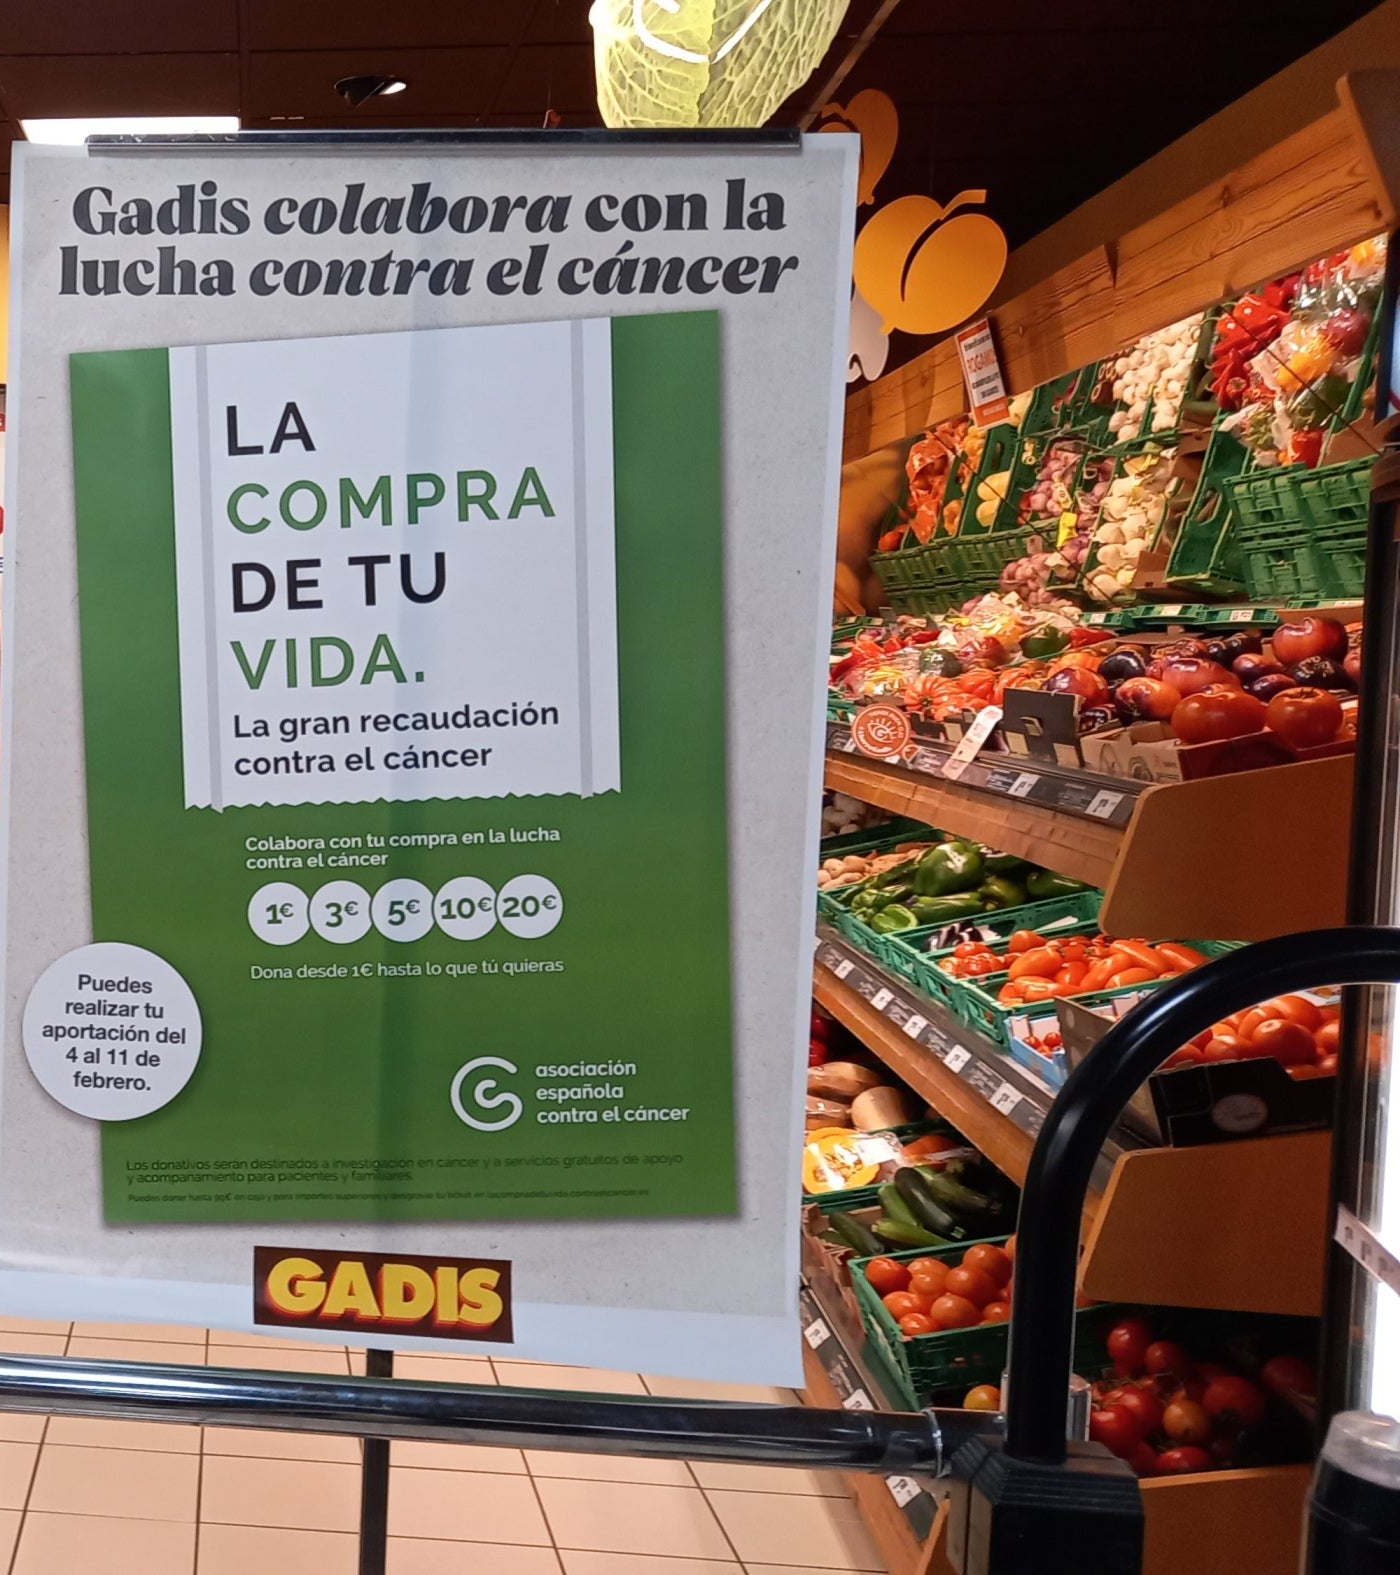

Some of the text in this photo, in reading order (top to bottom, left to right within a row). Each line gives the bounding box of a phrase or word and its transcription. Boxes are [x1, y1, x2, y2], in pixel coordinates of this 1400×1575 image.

[72, 178, 787, 235] Gadis colabora con la
[59, 240, 799, 297] lucha contra el cáncer
[226, 402, 316, 457] LA
[227, 467, 557, 535] COMPRA
[231, 552, 448, 613] DE TU
[230, 634, 428, 690] VIDA.
[234, 700, 560, 744] La gran recaudación
[234, 744, 493, 777] contra el cáncer
[245, 827, 561, 851] Colabora con tu compra en la lucha
[246, 851, 389, 870] contra el cáncer
[265, 894, 558, 928] 1€ 3€ 5€ 10€ 20€
[250, 958, 565, 980] Dona desde 1€ hasta lo que tú quieras
[77, 974, 153, 994] Puedes
[65, 999, 164, 1019] realizar tu
[42, 1023, 186, 1044] aportación del
[65, 1046, 161, 1067] 4 al 11 de
[73, 1071, 151, 1091] febrero.
[535, 1060, 637, 1078] asociación
[535, 1083, 624, 1104] española
[536, 1105, 690, 1124] contra el cáncer
[265, 1257, 503, 1328] GADIS
